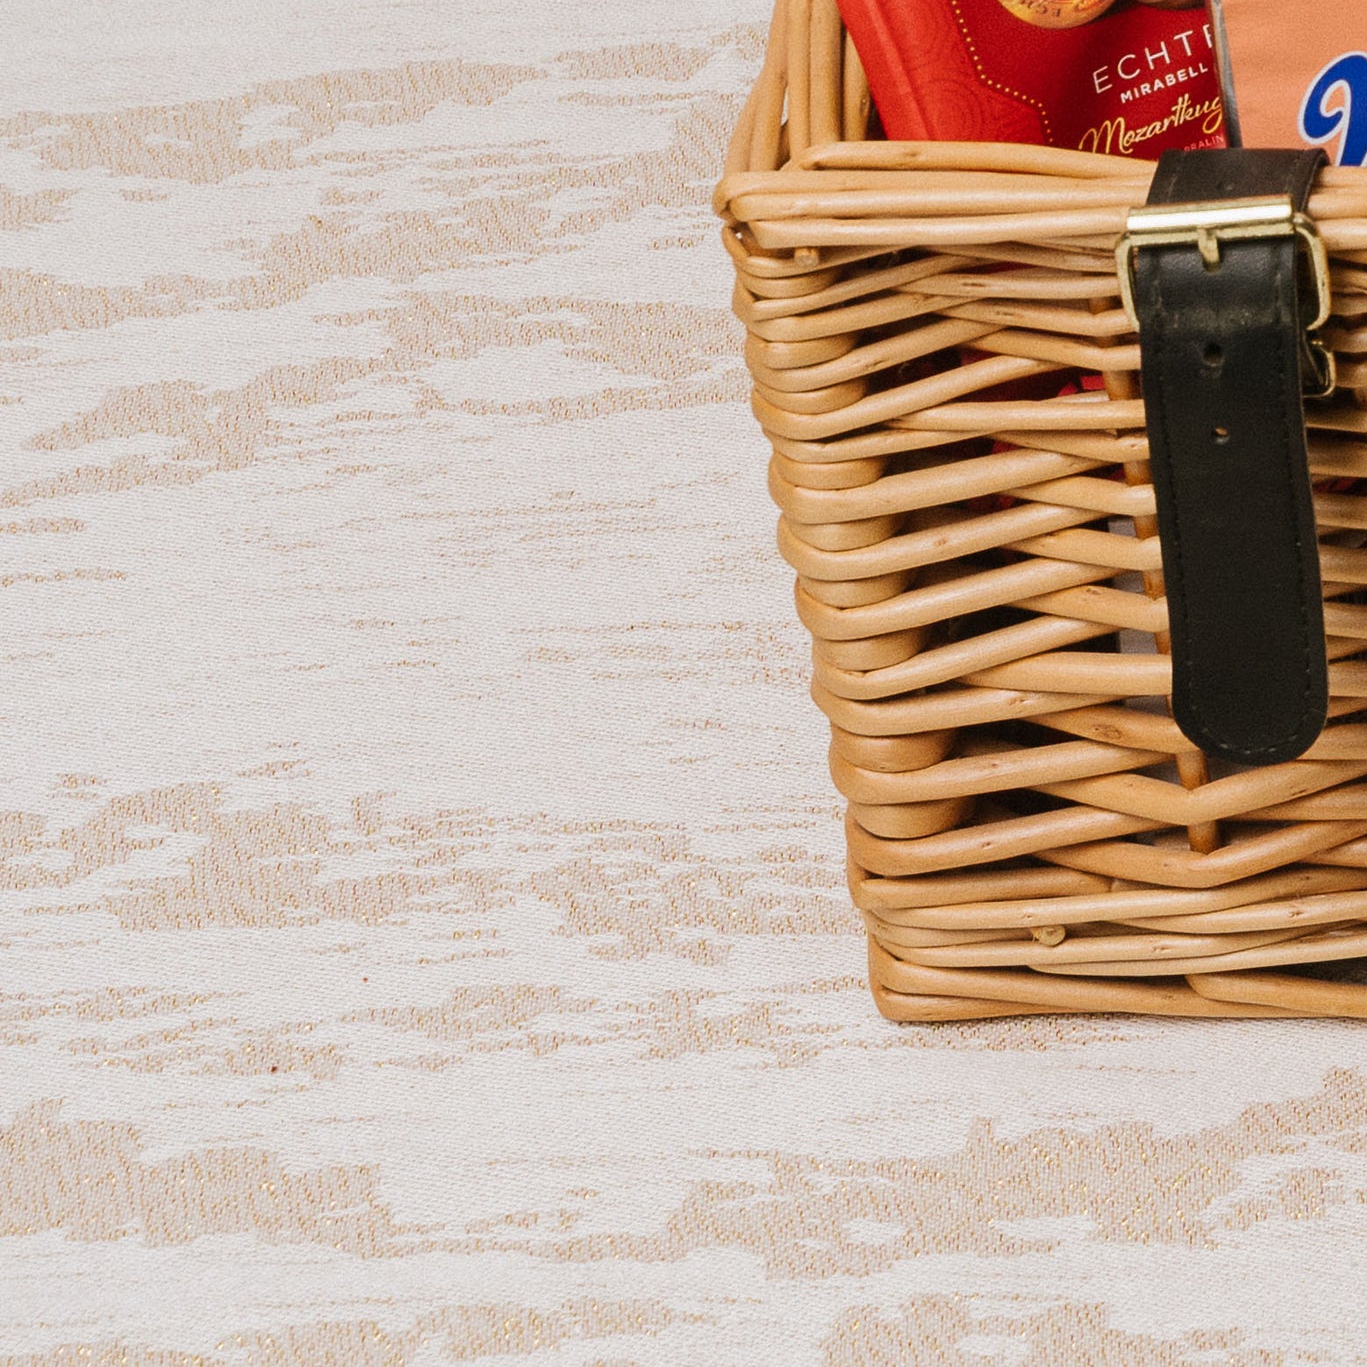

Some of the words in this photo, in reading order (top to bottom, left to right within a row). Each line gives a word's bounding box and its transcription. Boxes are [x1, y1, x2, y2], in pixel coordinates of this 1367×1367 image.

[1120, 62, 1208, 103] MIRABELL
[1078, 93, 1223, 155] Mozartkug
[1183, 133, 1224, 153] PRALIN
